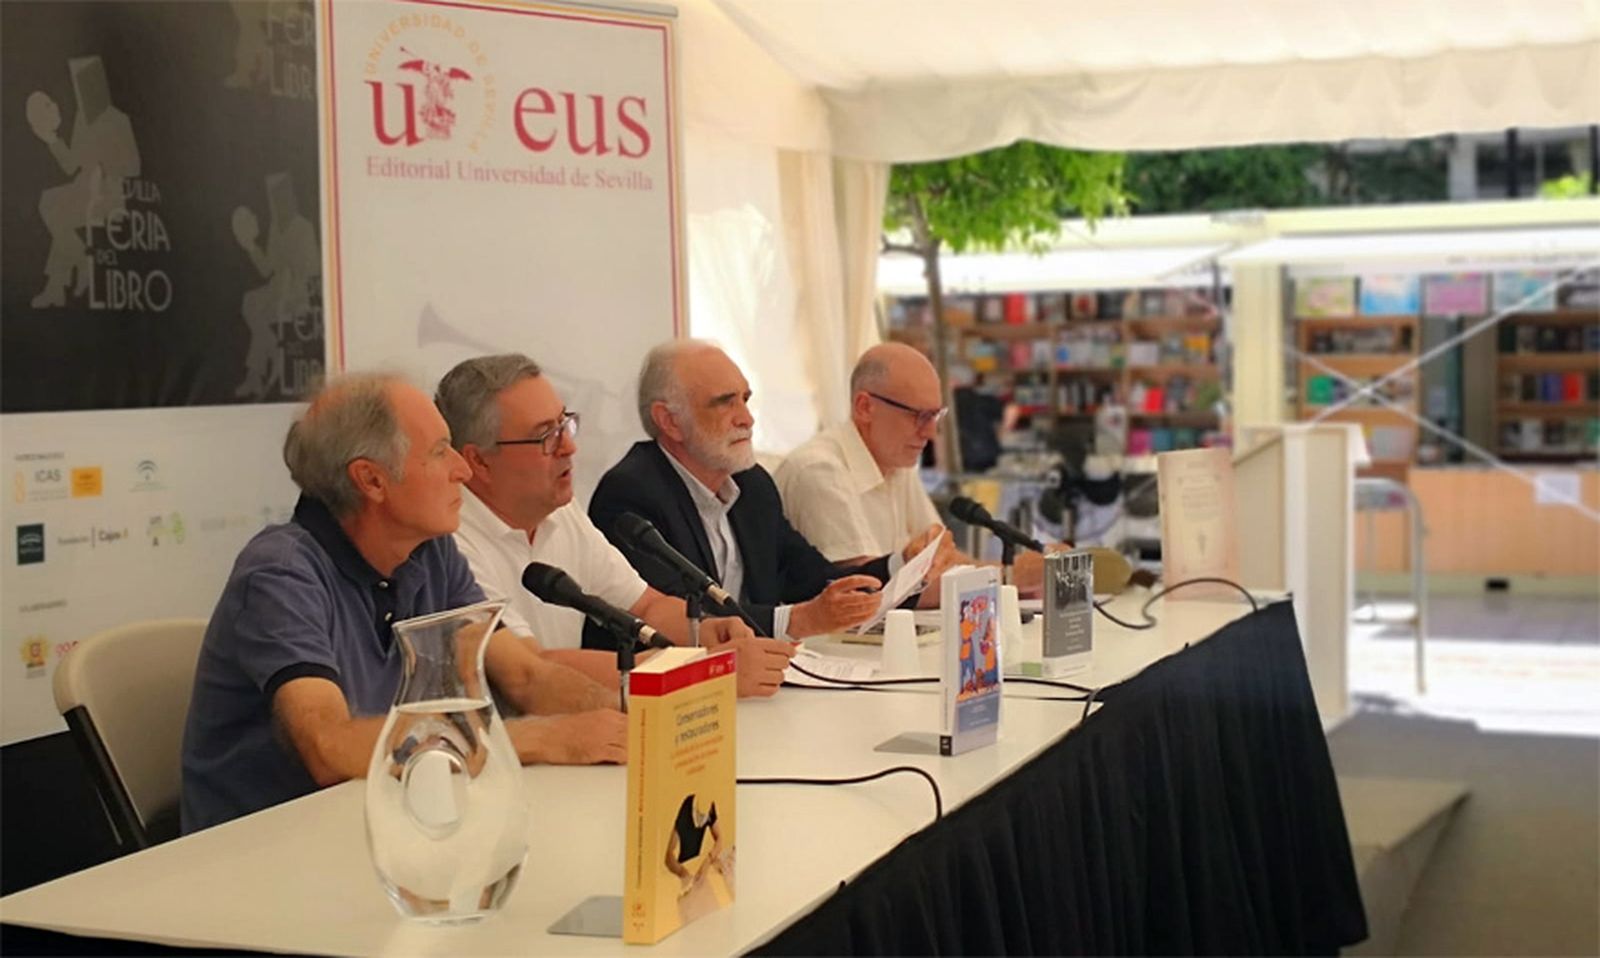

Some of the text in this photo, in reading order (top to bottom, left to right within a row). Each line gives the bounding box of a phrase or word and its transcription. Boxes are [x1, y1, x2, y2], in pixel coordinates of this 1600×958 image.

[512, 87, 652, 159] eus
[365, 155, 653, 191] Editorial Universidad de Sevilla
[86, 209, 171, 252] FERIA
[89, 269, 173, 311] LIBRO
